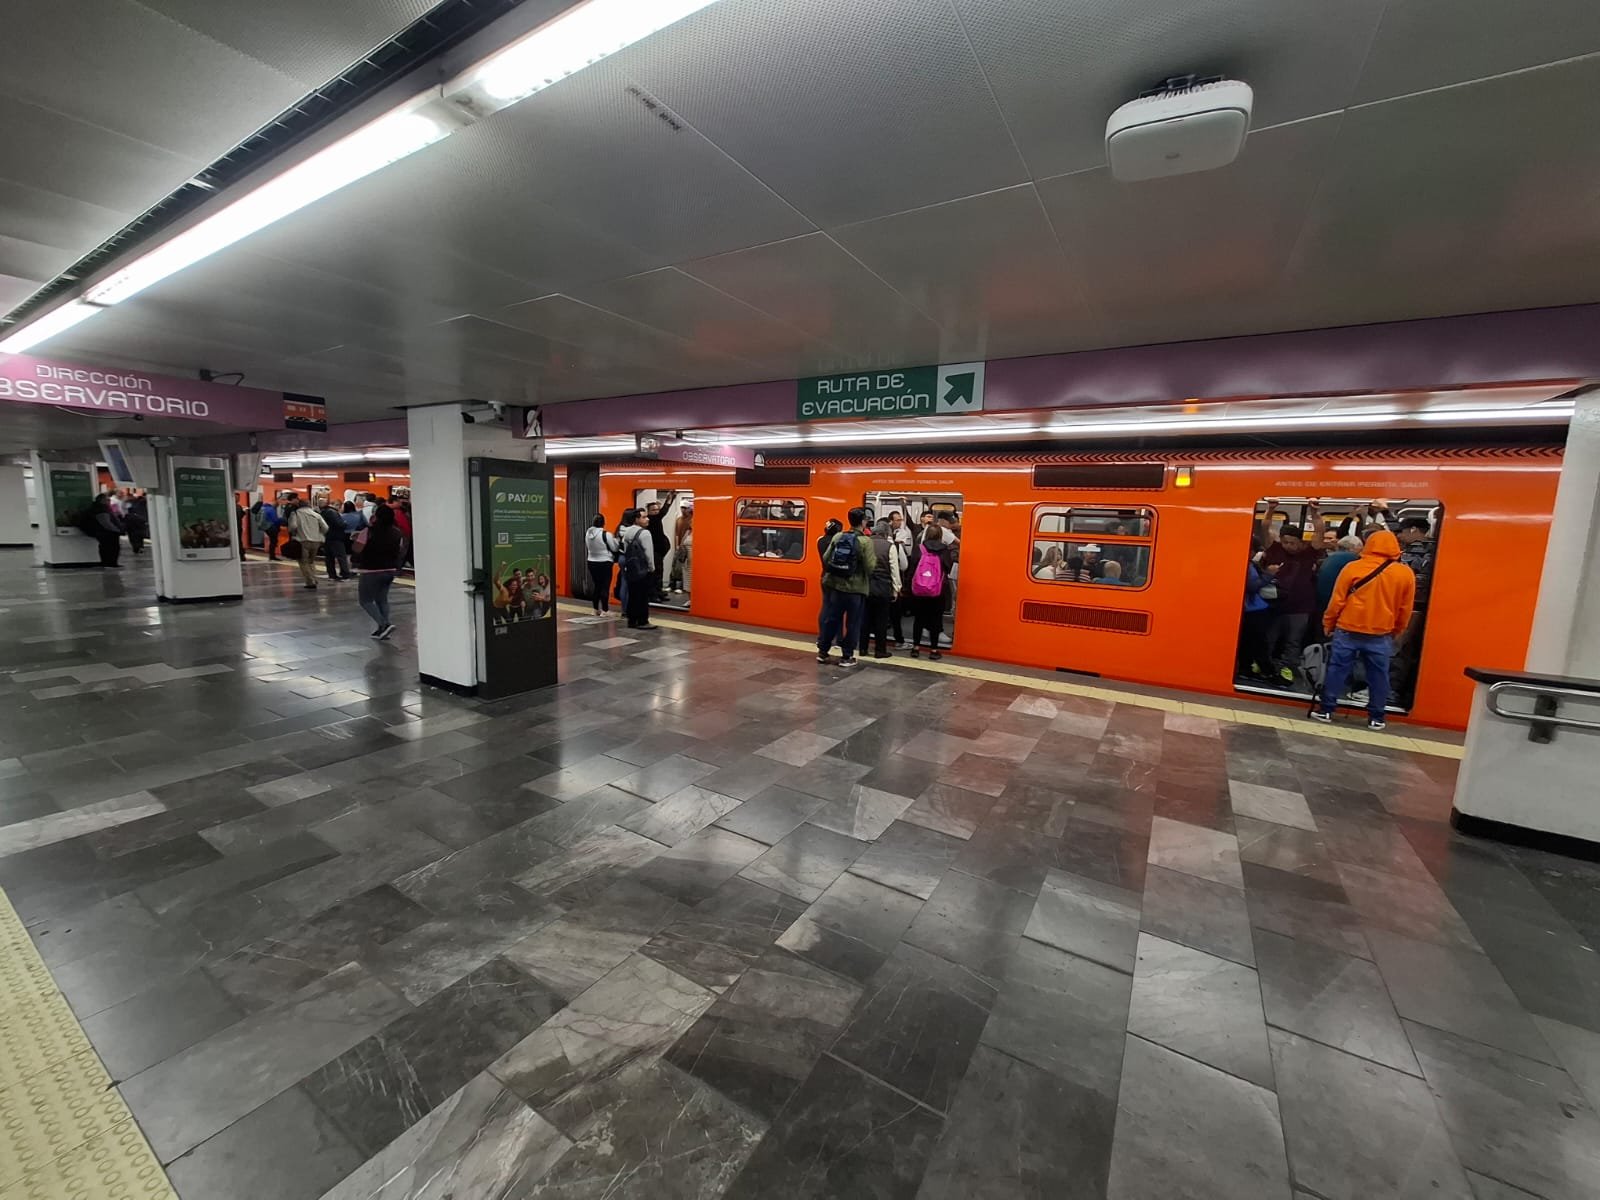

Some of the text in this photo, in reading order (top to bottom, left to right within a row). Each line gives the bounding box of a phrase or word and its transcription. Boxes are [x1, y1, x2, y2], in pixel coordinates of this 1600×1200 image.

[36, 364, 152, 391] DIRECCIÓN
[817, 373, 905, 395] RUTA DE
[802, 388, 930, 416] EVACUACIÓN
[507, 493, 544, 503] PAYJOY
